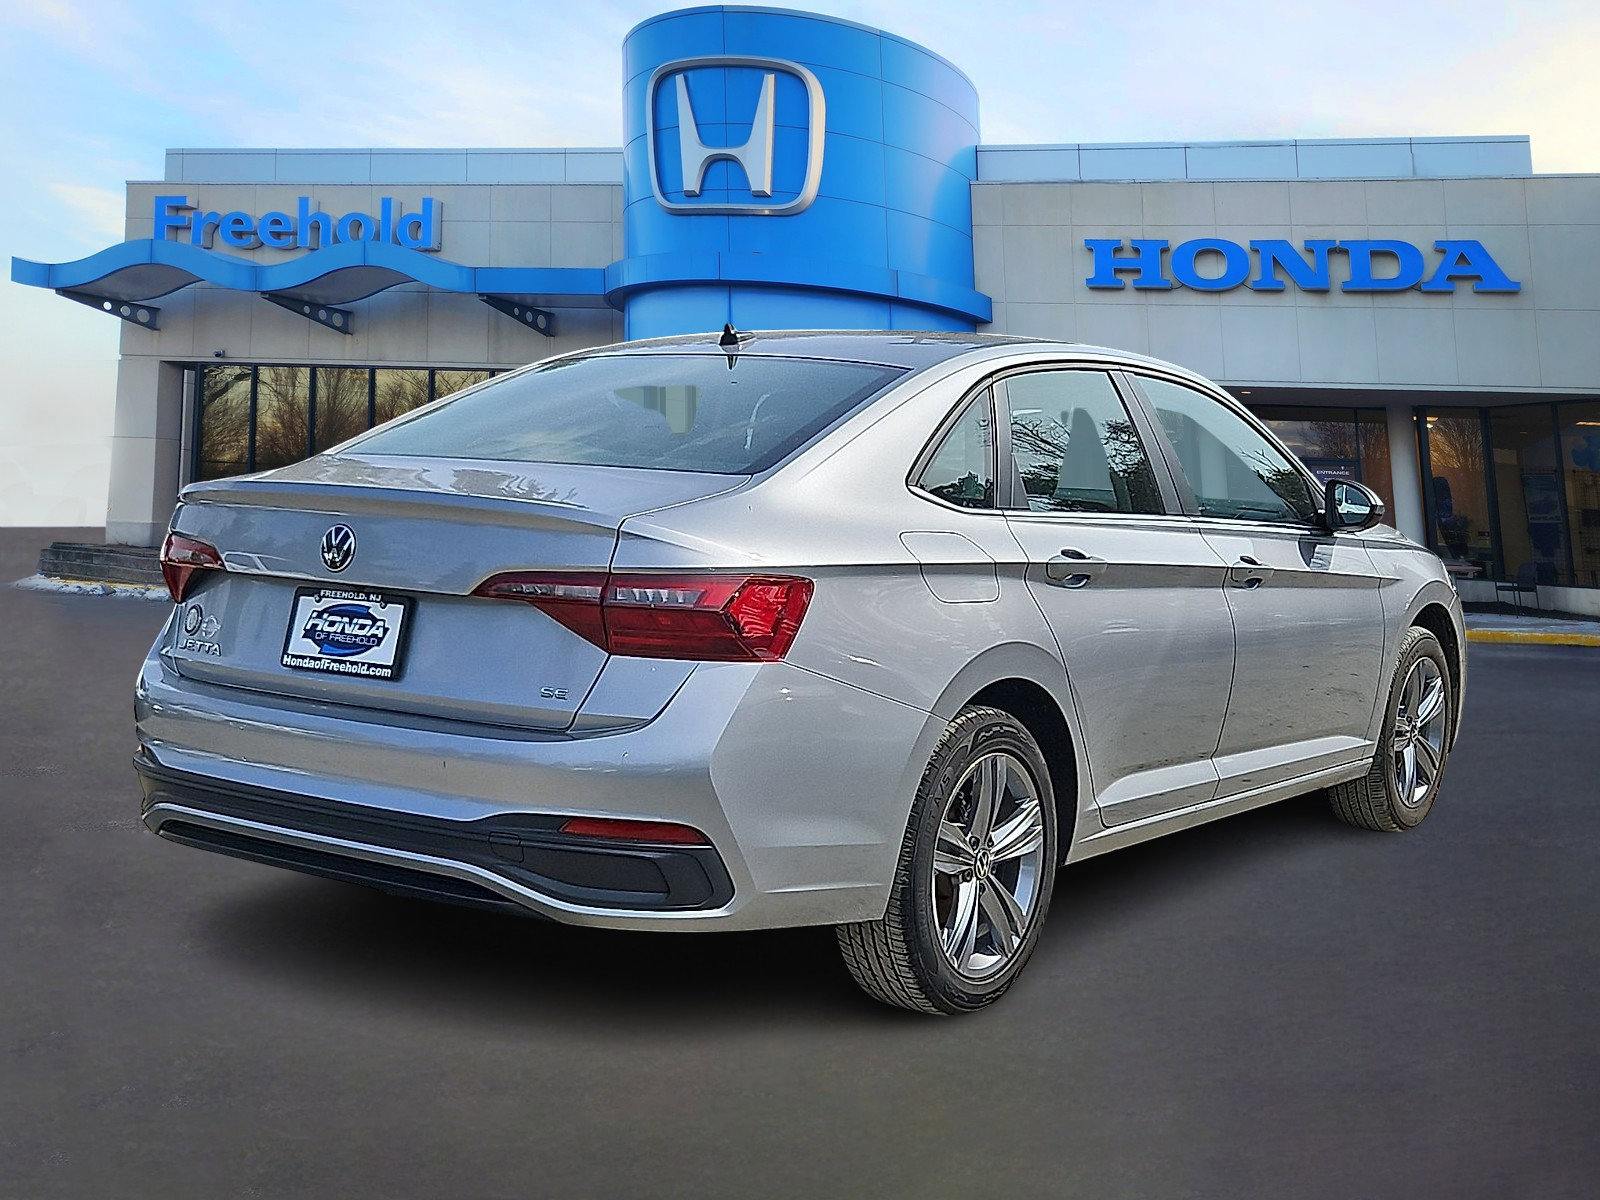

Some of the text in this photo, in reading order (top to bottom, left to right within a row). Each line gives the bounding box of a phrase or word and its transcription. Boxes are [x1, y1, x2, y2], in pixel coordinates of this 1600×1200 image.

[154, 195, 435, 249] Freehold
[1084, 238, 1521, 292] HONDA
[369, 594, 382, 602] NJ
[306, 612, 385, 637] HONDA
[179, 638, 222, 657] JETTA
[315, 632, 378, 646] OF FREEHOLD
[282, 654, 392, 677] HondaofFreehold.com
[540, 685, 569, 701] SE
